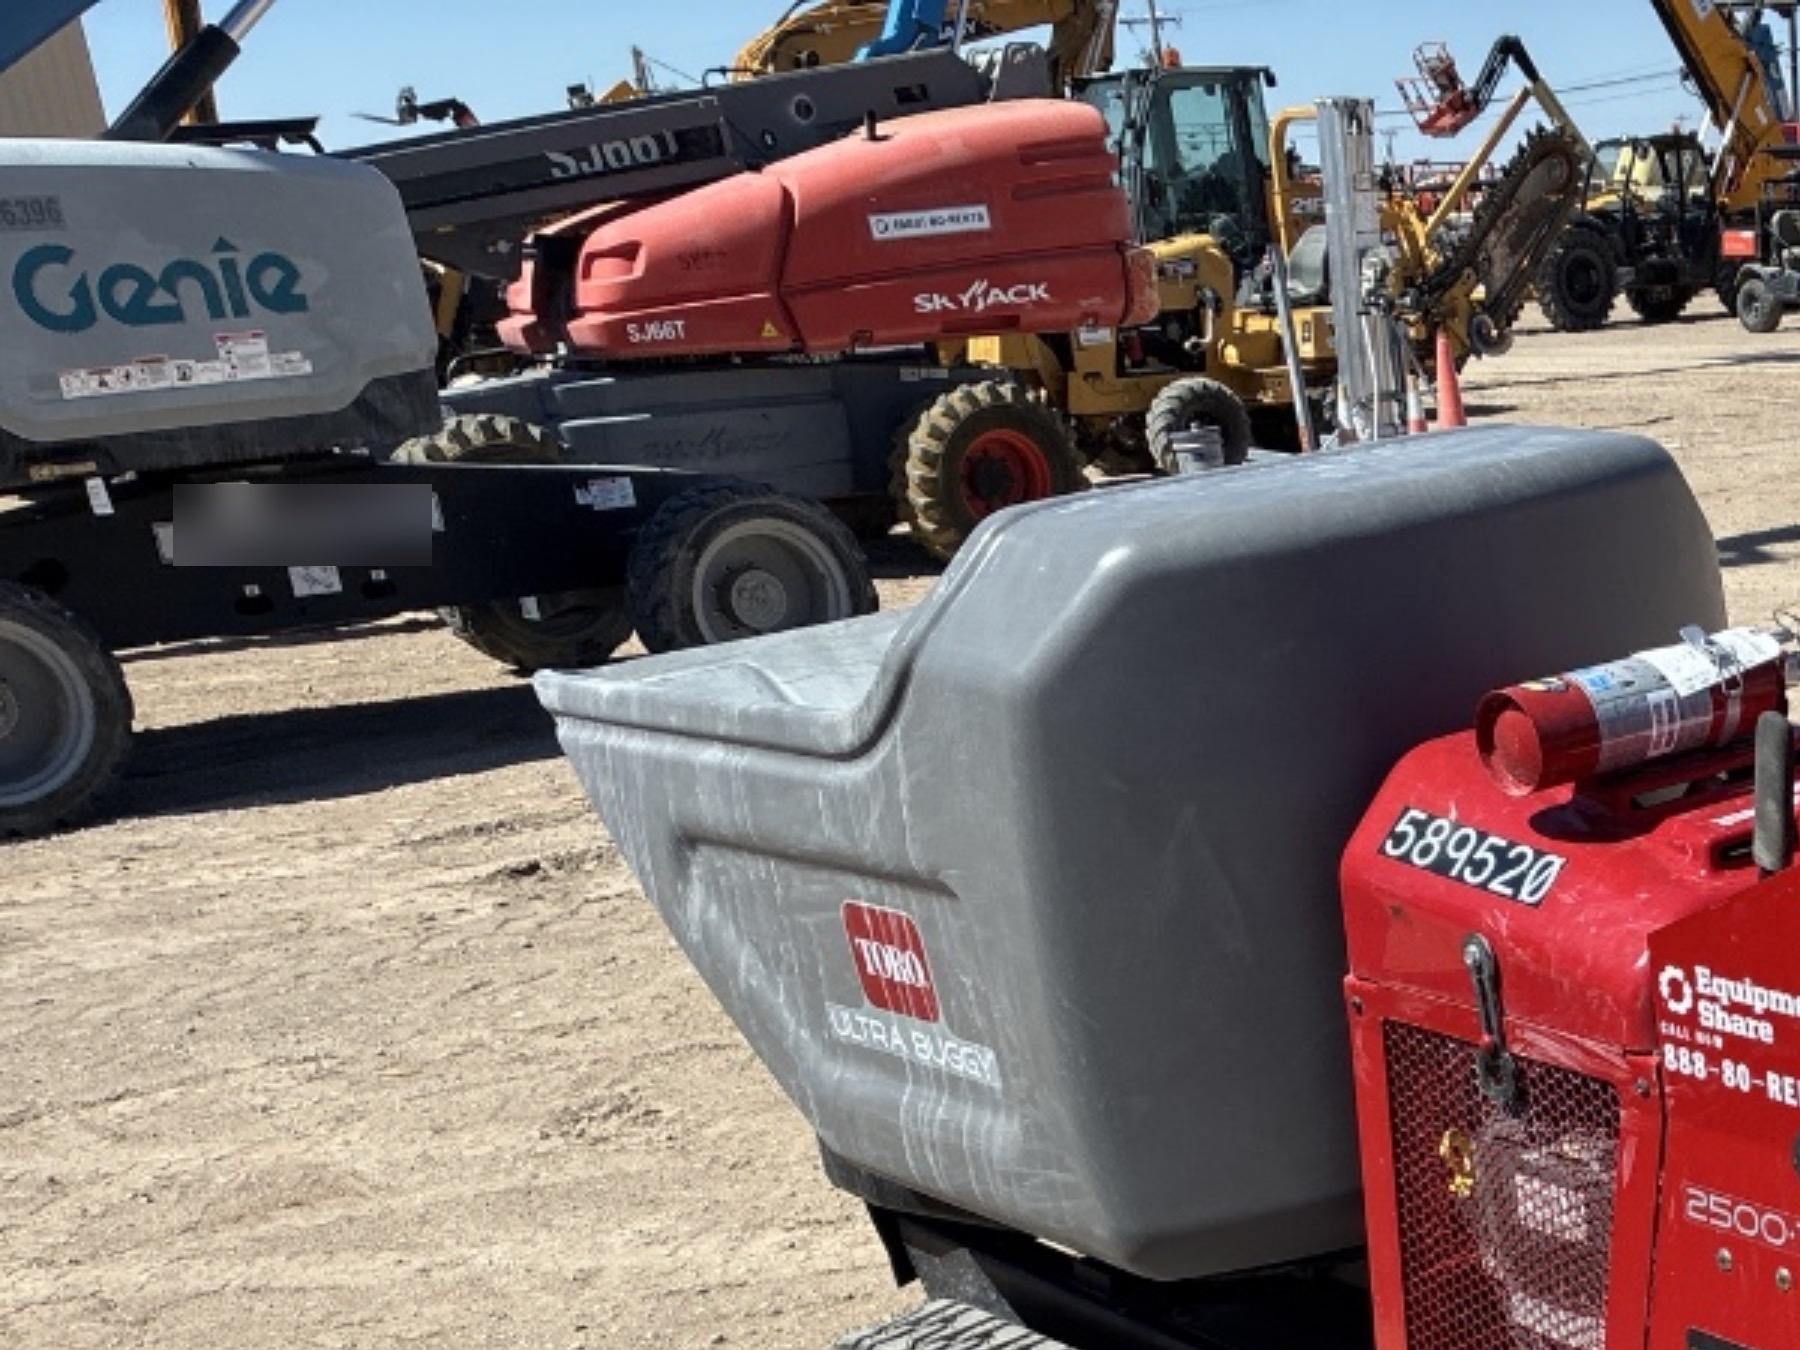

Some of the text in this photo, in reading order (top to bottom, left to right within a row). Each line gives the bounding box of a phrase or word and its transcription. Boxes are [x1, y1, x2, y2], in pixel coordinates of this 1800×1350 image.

[12, 235, 309, 334] Genie
[912, 278, 1051, 314] SKYJACK
[1383, 810, 1565, 905] 589520
[854, 937, 930, 988] TORO
[1697, 1000, 1775, 1045] Share
